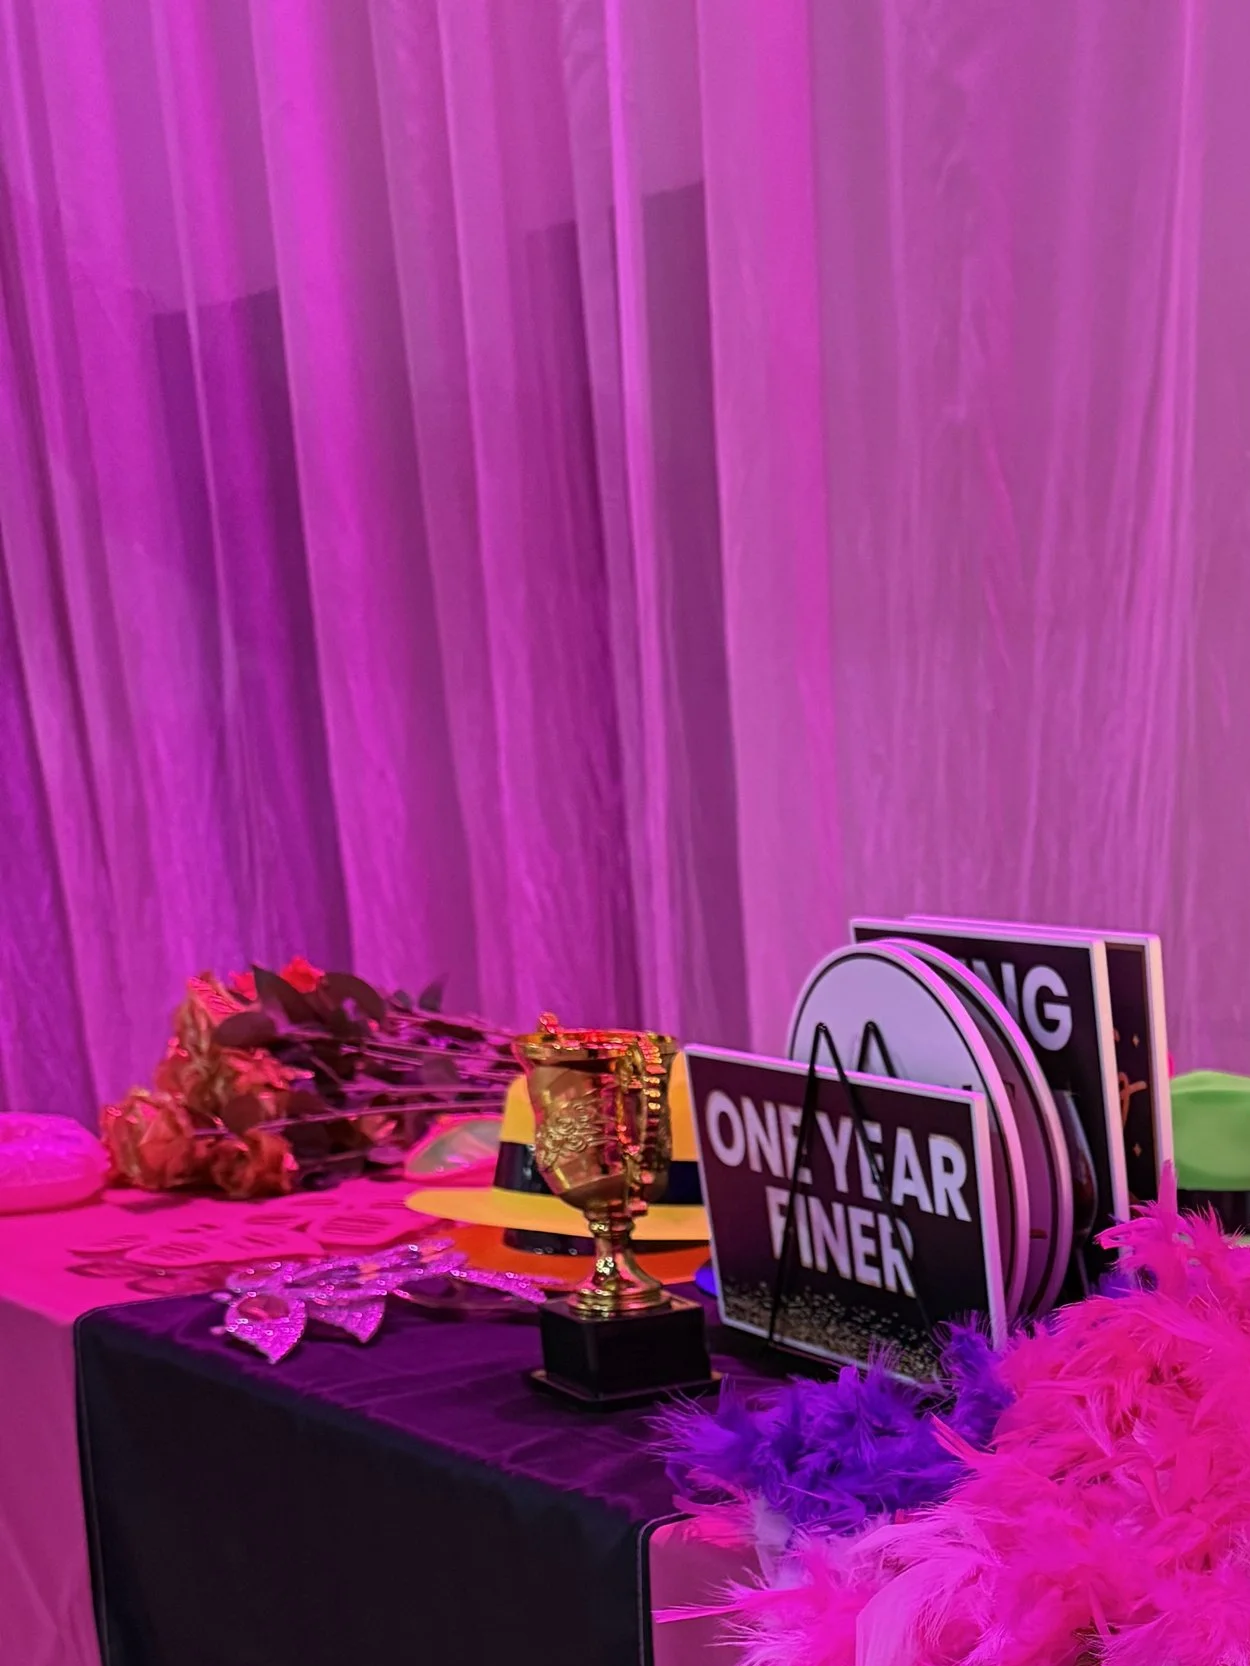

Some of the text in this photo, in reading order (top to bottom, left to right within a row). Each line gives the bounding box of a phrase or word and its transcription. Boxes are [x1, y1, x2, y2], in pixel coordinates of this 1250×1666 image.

[706, 1089, 972, 1222] ONE YEAR
[765, 1185, 916, 1298] FINER
